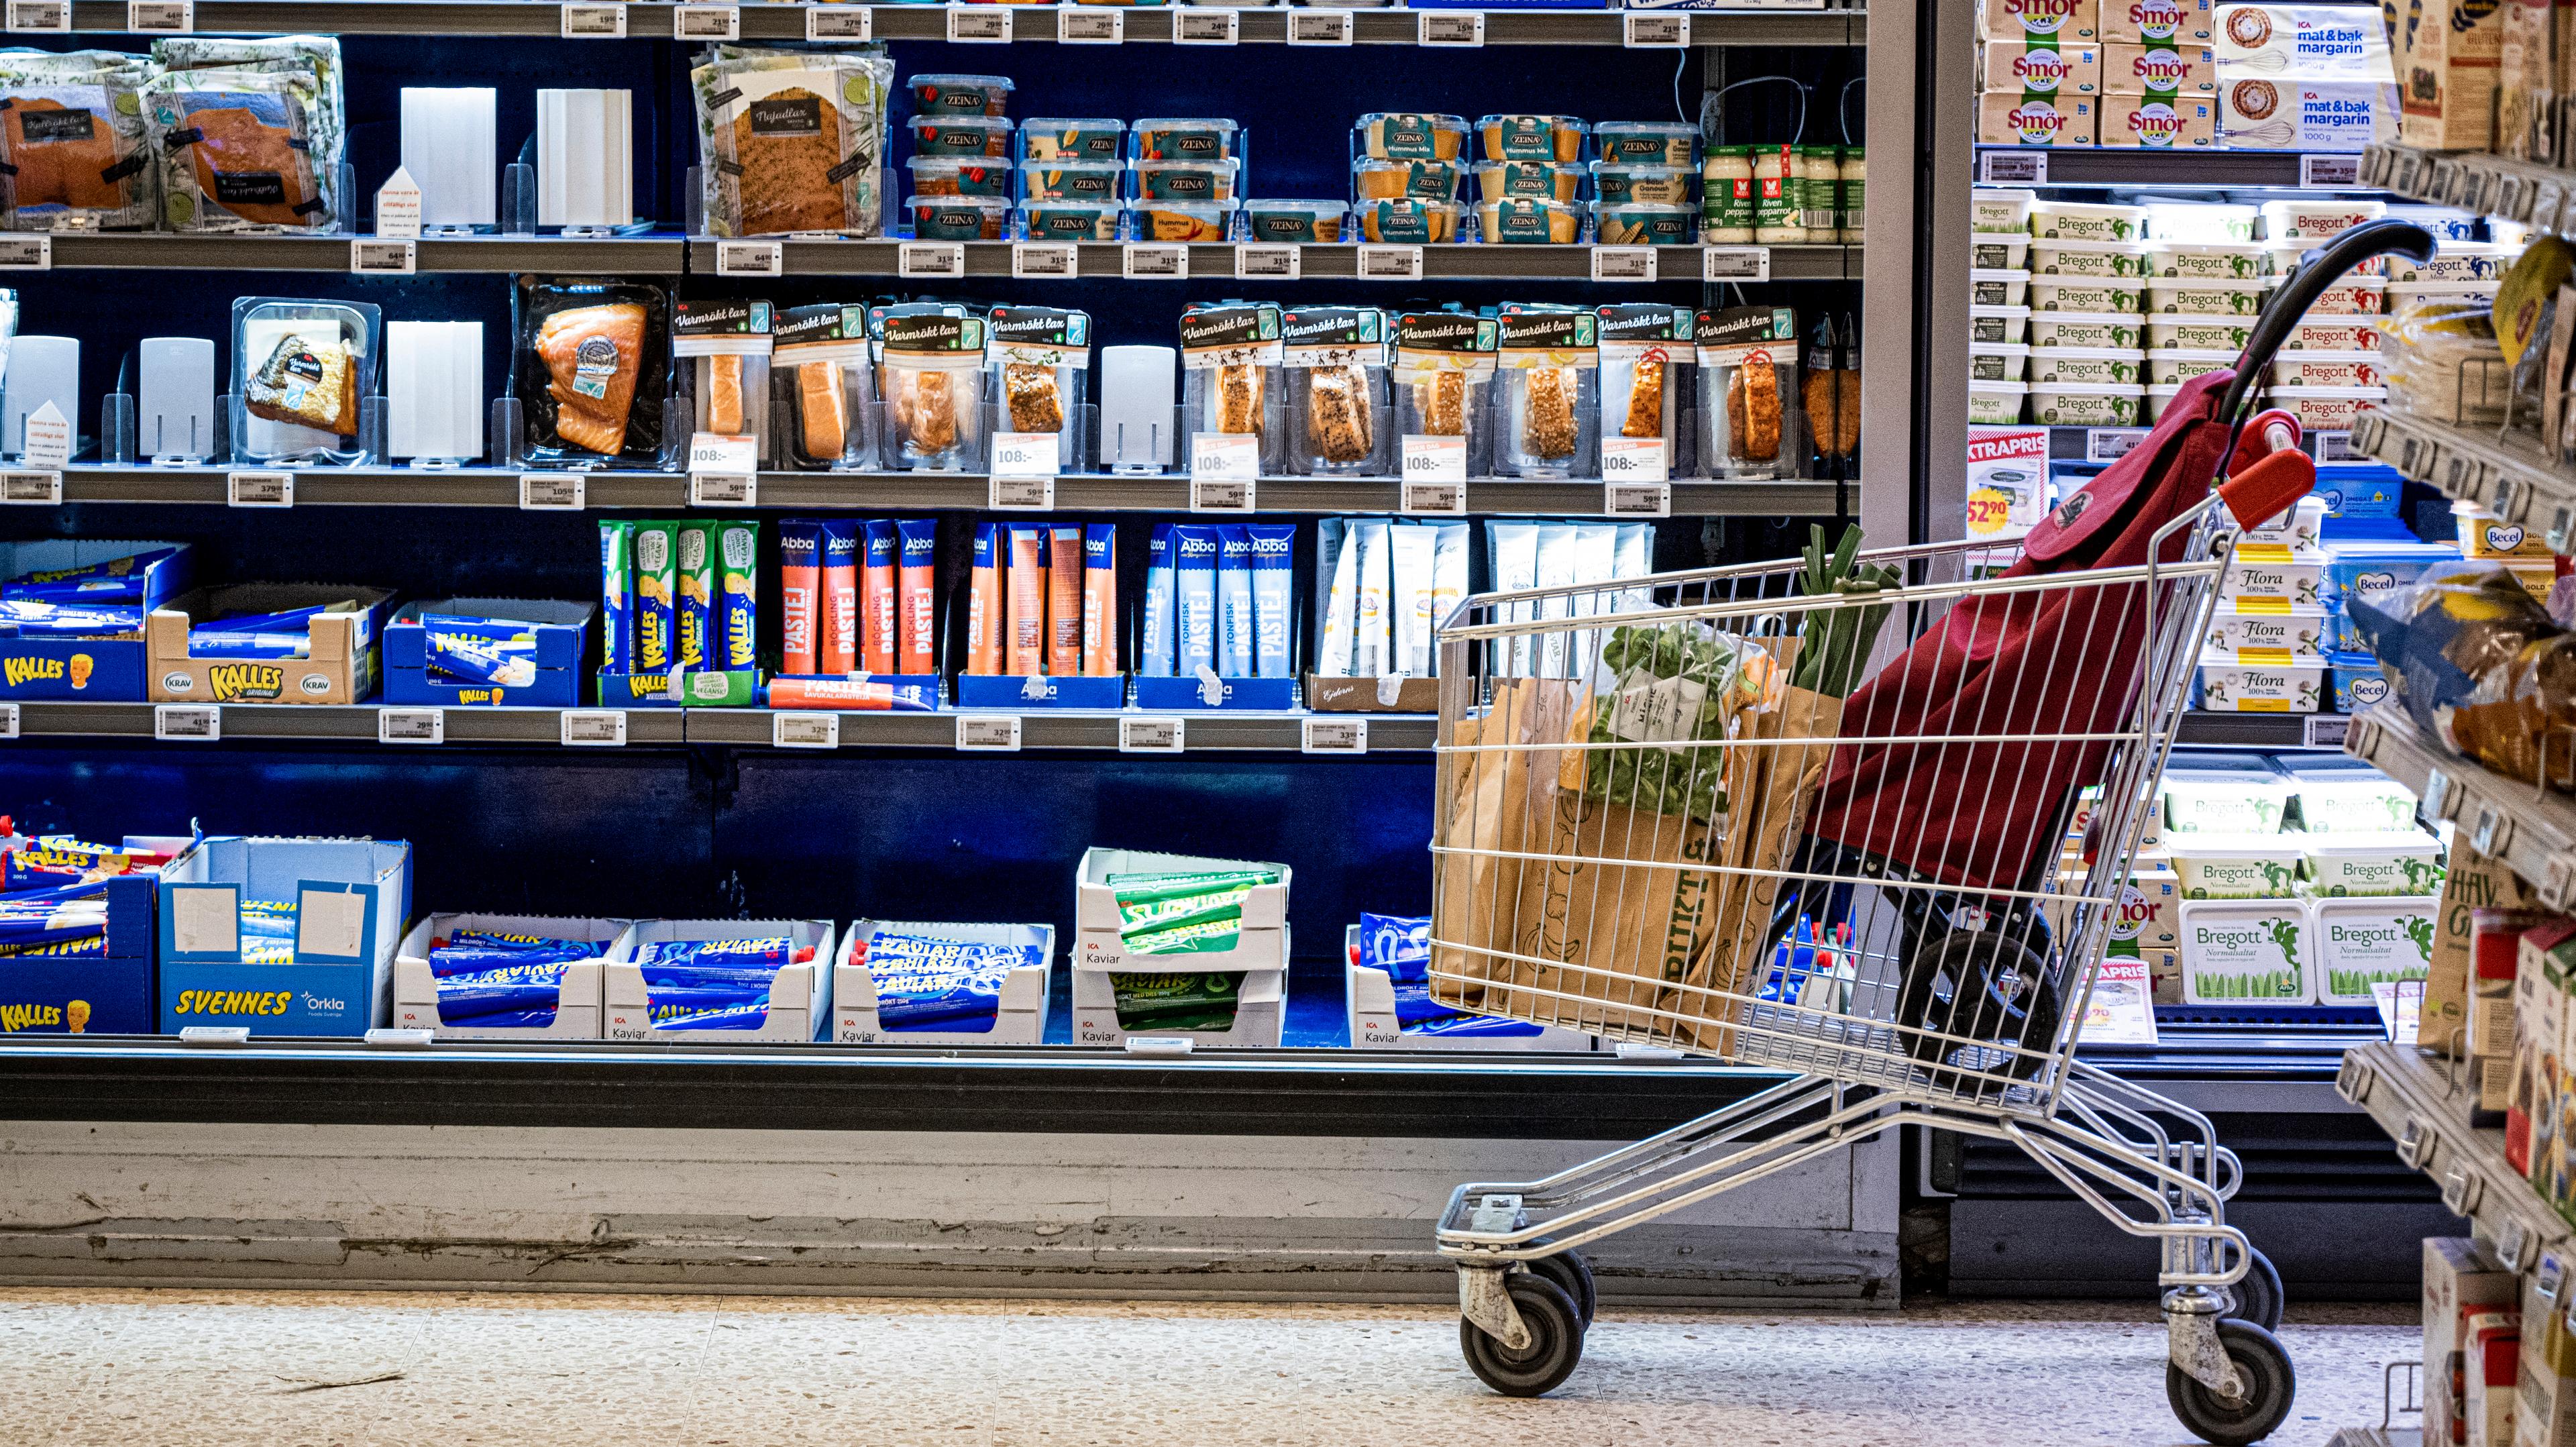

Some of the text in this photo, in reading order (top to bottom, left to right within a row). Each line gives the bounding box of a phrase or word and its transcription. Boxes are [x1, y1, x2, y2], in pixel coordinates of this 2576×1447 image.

[2129, 5, 2188, 25] Smör
[2298, 42, 2363, 55] margarin
[2012, 57, 2073, 79] Smör
[2133, 57, 2192, 78] Smör
[2008, 109, 2068, 131] Smör
[2127, 111, 2187, 133] Smör
[2304, 113, 2369, 126] margarin
[1762, 199, 1782, 207] Riven
[1758, 209, 1791, 219] pepparrot
[1980, 207, 2008, 218] Bregott
[2059, 217, 2104, 234] Bregott
[2299, 216, 2344, 232] Bregott
[2059, 253, 2104, 270] Bregott
[2178, 255, 2223, 272] Bregott
[2058, 288, 2104, 305] Bregott
[2178, 292, 2223, 309] Bregott
[675, 307, 747, 327] Varmrökt lax
[991, 318, 1065, 332] Varmrökt lax
[1599, 315, 1671, 331] Varmrökt lax
[885, 325, 959, 341] Varmrökt lax
[1183, 317, 1256, 339] Varmrökt lax
[1283, 318, 1356, 337] Varmrökt lax
[1401, 325, 1474, 339] Varmrökt lax
[1500, 323, 1572, 339] Varmrökt lax
[1697, 316, 1770, 337] Varmrökt lax
[2057, 325, 2103, 341] Bregott
[2178, 327, 2223, 343] Bregott
[2302, 328, 2348, 344] Bregott
[2057, 361, 2103, 377] Bregott
[2302, 364, 2348, 381] Bregott
[1971, 398, 2000, 408] Bregott
[2058, 396, 2104, 413] Bregott
[2302, 400, 2347, 417] Bregott
[694, 449, 727, 462] 108:-
[998, 450, 1032, 463] 108:-
[1968, 437, 2045, 460] XTRAPRIS
[1197, 457, 1231, 470] 108:-
[1406, 458, 1440, 470] 108:-
[1603, 458, 1638, 470] 108:-
[782, 537, 814, 550] Abba
[906, 538, 934, 550] Abba
[1181, 540, 1216, 552] Abba
[1252, 540, 1288, 552] Abba
[2489, 532, 2519, 543] Becel
[2240, 569, 2284, 587] Flora
[2360, 578, 2391, 590] Becel
[785, 588, 805, 653] PASTEJ
[838, 588, 855, 654] PASTEJ
[881, 588, 894, 654] PASTEJ
[916, 588, 932, 654] PASTEJ
[1190, 590, 1212, 657] PASTEJ
[1236, 590, 1251, 657] PASTEJ
[1260, 590, 1283, 657] PASTEJ
[682, 610, 703, 666] KALLES
[729, 607, 754, 666] KALLES
[2242, 621, 2286, 639] Flora
[642, 610, 666, 669] KALLES
[4, 656, 64, 686] KALLES
[169, 679, 191, 688] KRAV
[209, 664, 283, 700] KALLES
[306, 680, 329, 690] KRAV
[805, 680, 871, 694] PASTEJ
[2242, 672, 2286, 690] Flora
[2355, 684, 2384, 695] Becel
[246, 688, 274, 697] ORIGINAL
[459, 689, 489, 704] KALLES
[1323, 685, 1354, 702] Ejderns
[39, 837, 115, 855] KALLES
[13, 851, 90, 871] KALLES
[2204, 865, 2255, 884] Bregott
[2343, 862, 2394, 881] Bregott
[1664, 870, 1709, 981] RUKT
[2197, 928, 2262, 949] Bregott
[2331, 925, 2398, 947] Bregott
[2206, 947, 2257, 957] Normalsaltat
[2340, 945, 2392, 955] Normalsaltat
[1087, 954, 1120, 964] Kaviar
[174, 990, 292, 1016] SVENNES
[307, 998, 344, 1010] Orkla
[1, 1006, 61, 1033] KALLES
[613, 1028, 646, 1040] Kaviar
[843, 1030, 876, 1041] Kaviar
[1082, 1031, 1116, 1042] Kaviar
[1365, 1032, 1399, 1044] Kaviar
